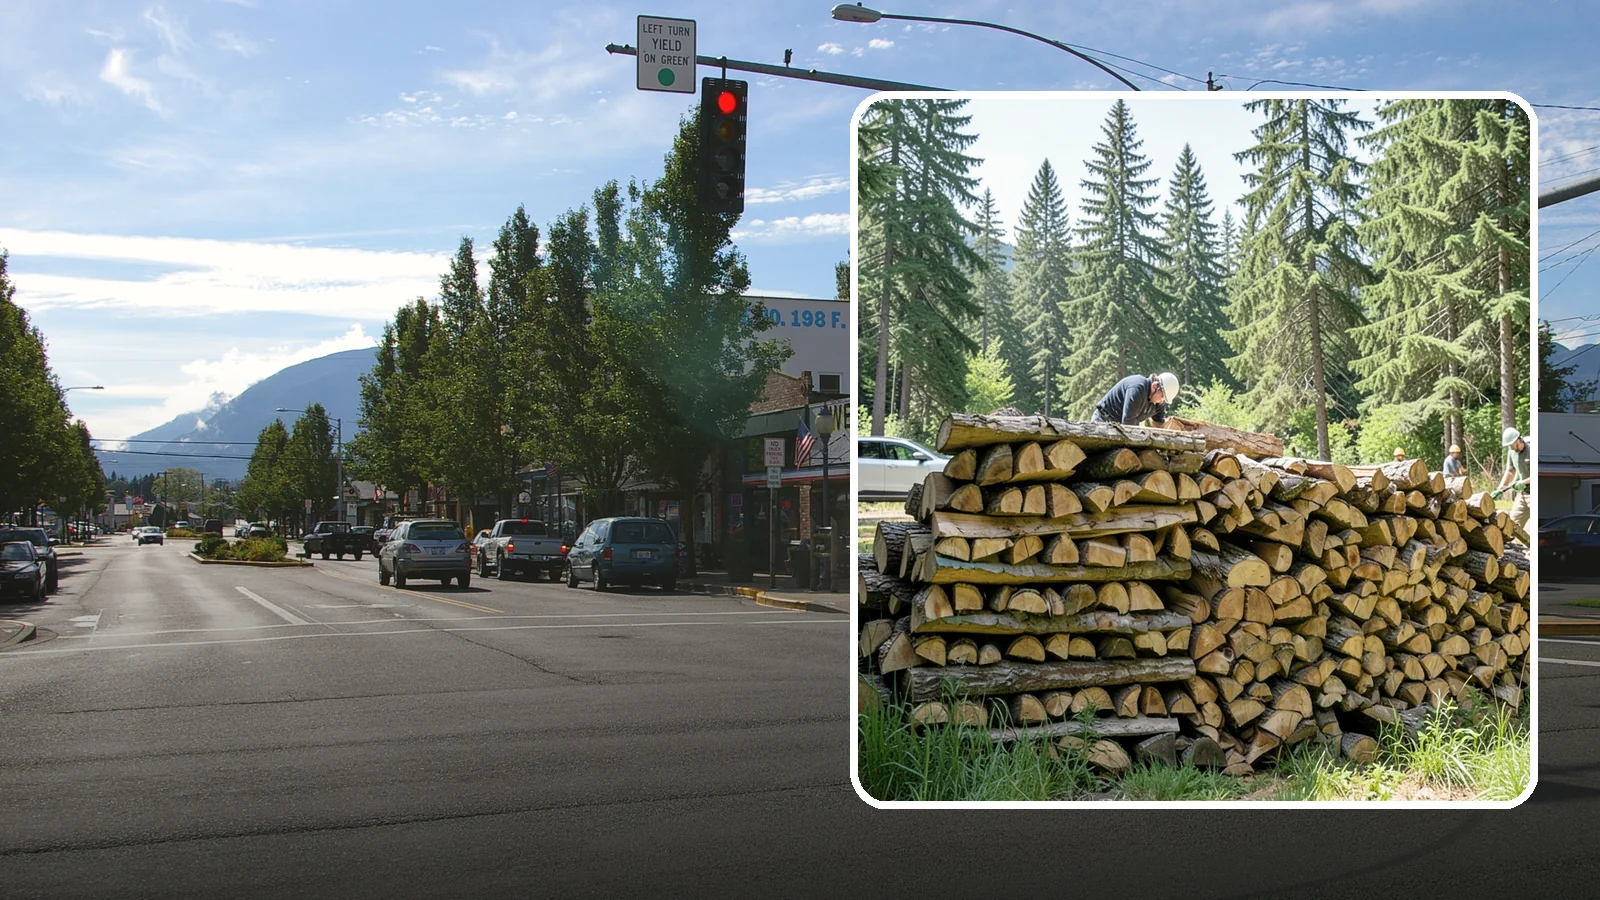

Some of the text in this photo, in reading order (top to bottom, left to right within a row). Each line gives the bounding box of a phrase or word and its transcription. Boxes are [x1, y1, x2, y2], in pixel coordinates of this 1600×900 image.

[643, 24, 690, 36] LEFT TURN
[652, 38, 682, 52] YIELD
[644, 53, 689, 66] ON GREEN
[791, 309, 826, 328] 198
[831, 311, 846, 329] F.
